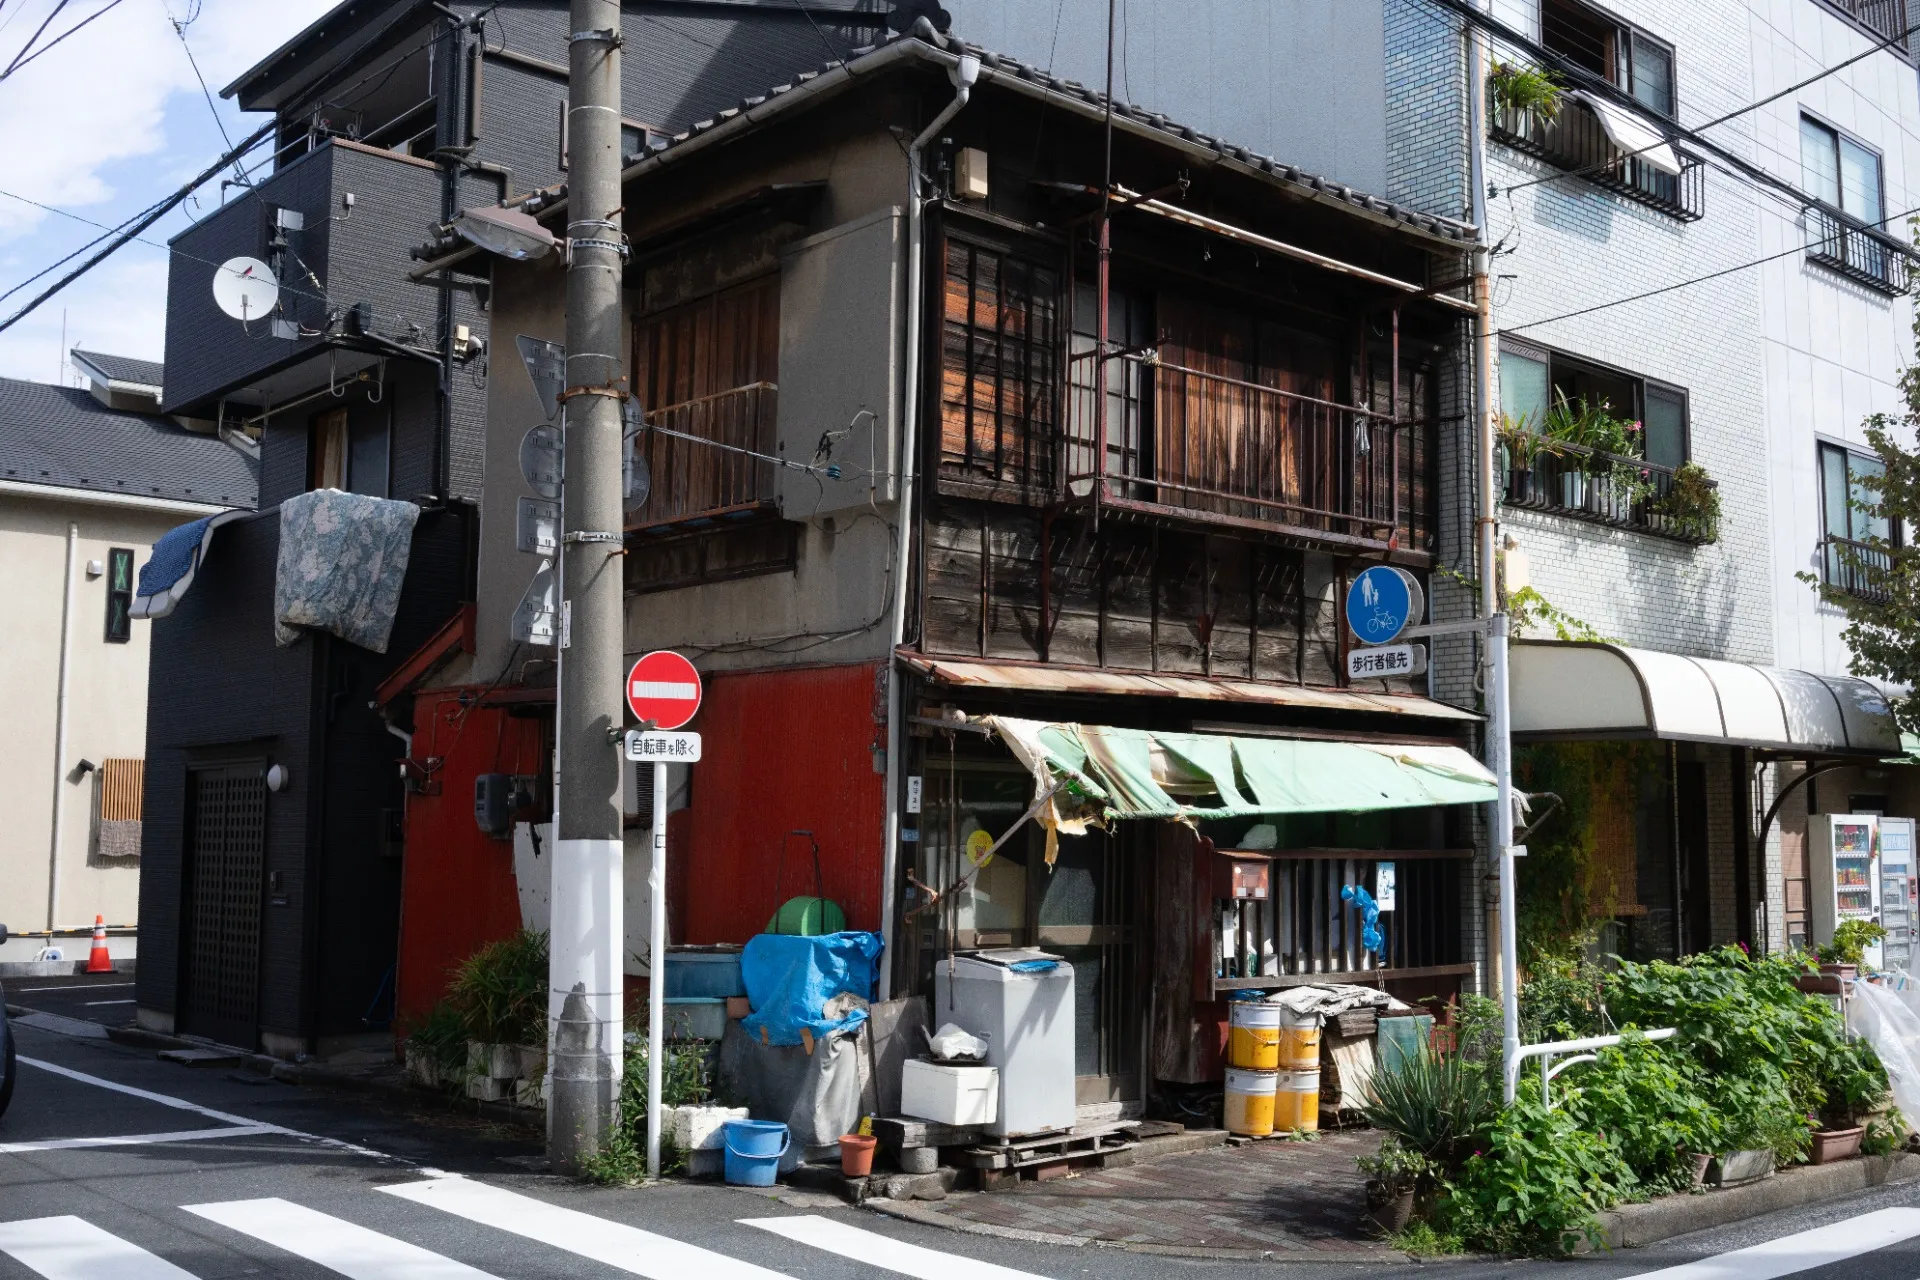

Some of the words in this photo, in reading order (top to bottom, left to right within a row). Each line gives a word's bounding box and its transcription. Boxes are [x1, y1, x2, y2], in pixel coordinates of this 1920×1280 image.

[1352, 651, 1408, 673] 歩行者優先
[632, 738, 694, 756] 自転車を除く
